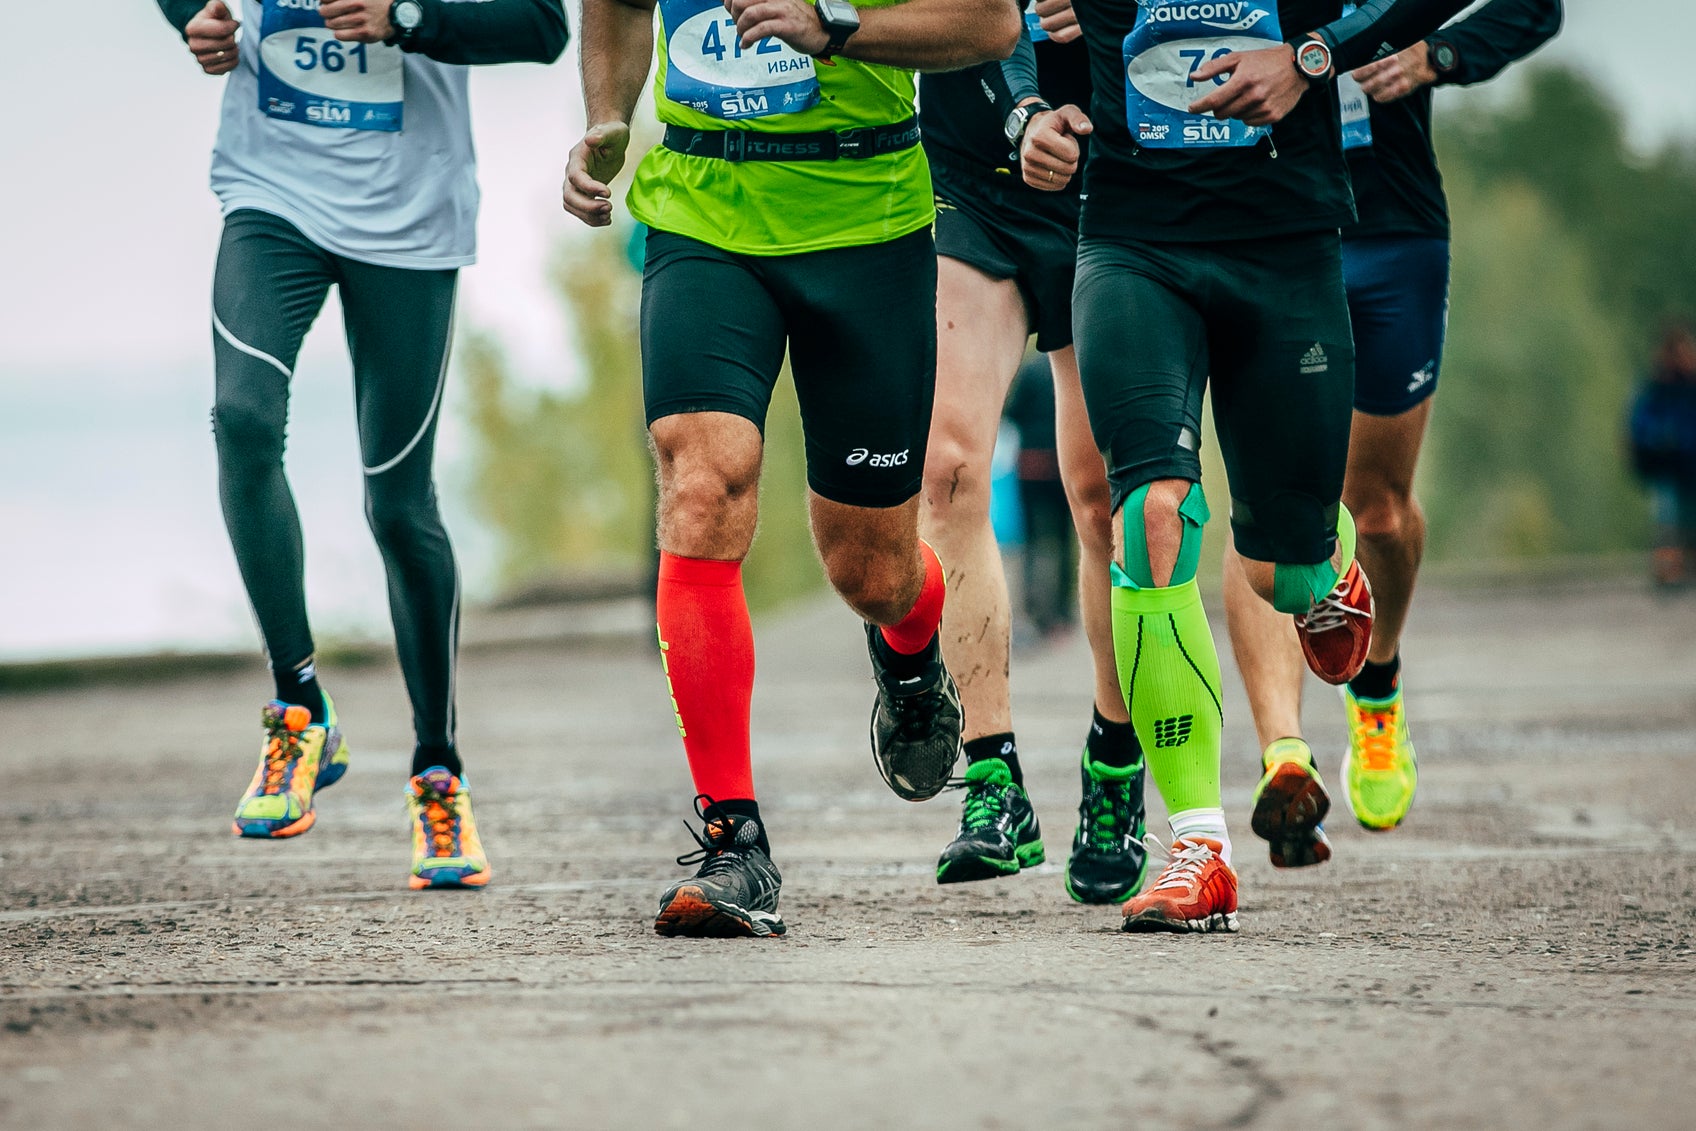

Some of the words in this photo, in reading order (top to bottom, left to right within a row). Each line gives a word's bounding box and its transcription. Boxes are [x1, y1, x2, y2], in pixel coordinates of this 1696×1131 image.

[294, 36, 369, 74] 561
[767, 56, 810, 75] ИВАН
[692, 100, 709, 109] 2015
[1139, 131, 1166, 140] OMSK
[1151, 124, 1170, 134] 2015
[868, 448, 910, 468] asics
[1155, 735, 1190, 749] cep
